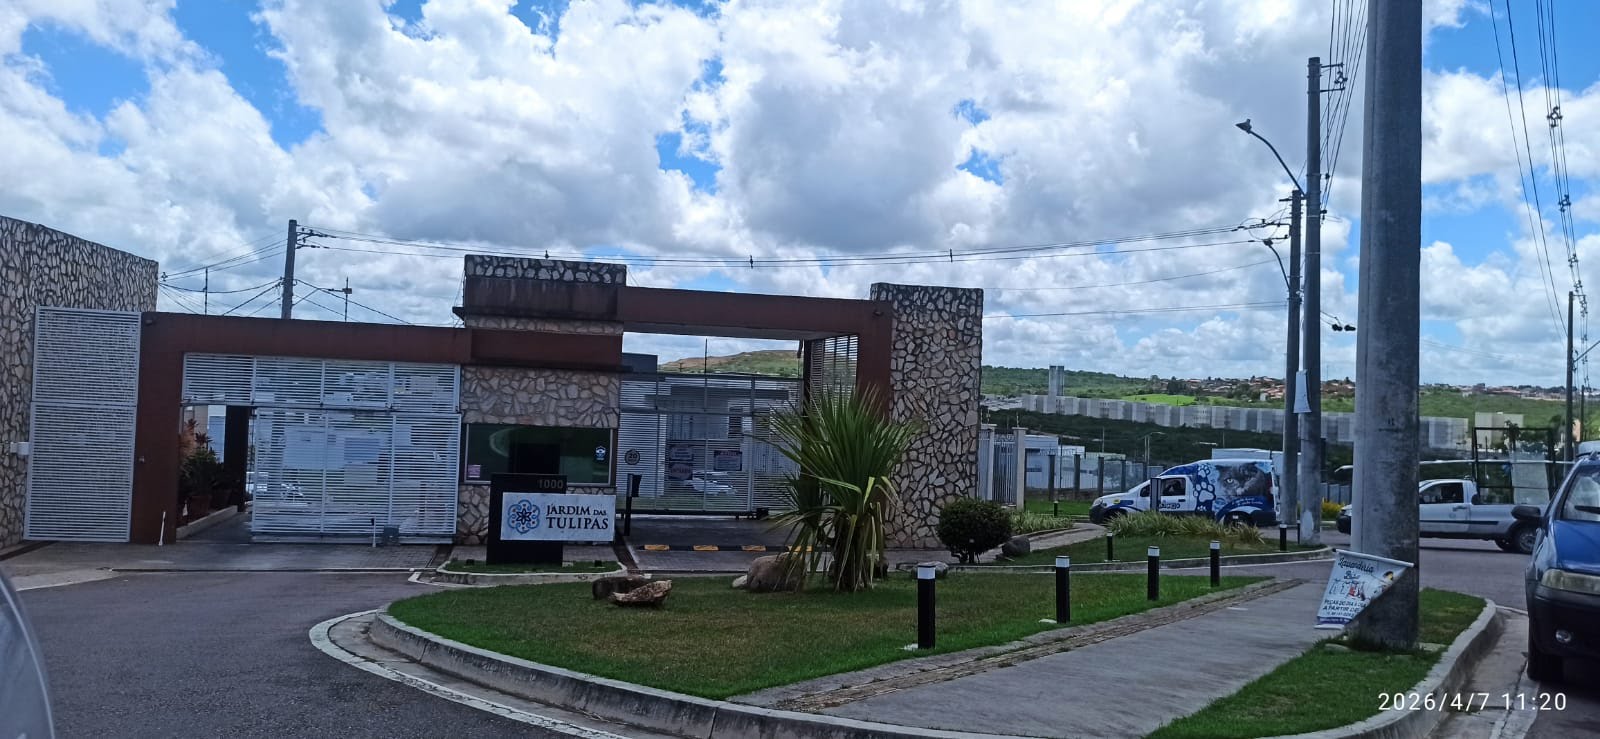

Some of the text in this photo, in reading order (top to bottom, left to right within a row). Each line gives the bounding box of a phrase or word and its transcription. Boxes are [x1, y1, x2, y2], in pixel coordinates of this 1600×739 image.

[537, 479, 564, 489] 1000
[546, 505, 591, 516] JARDIM
[546, 517, 609, 530] TULIPAS
